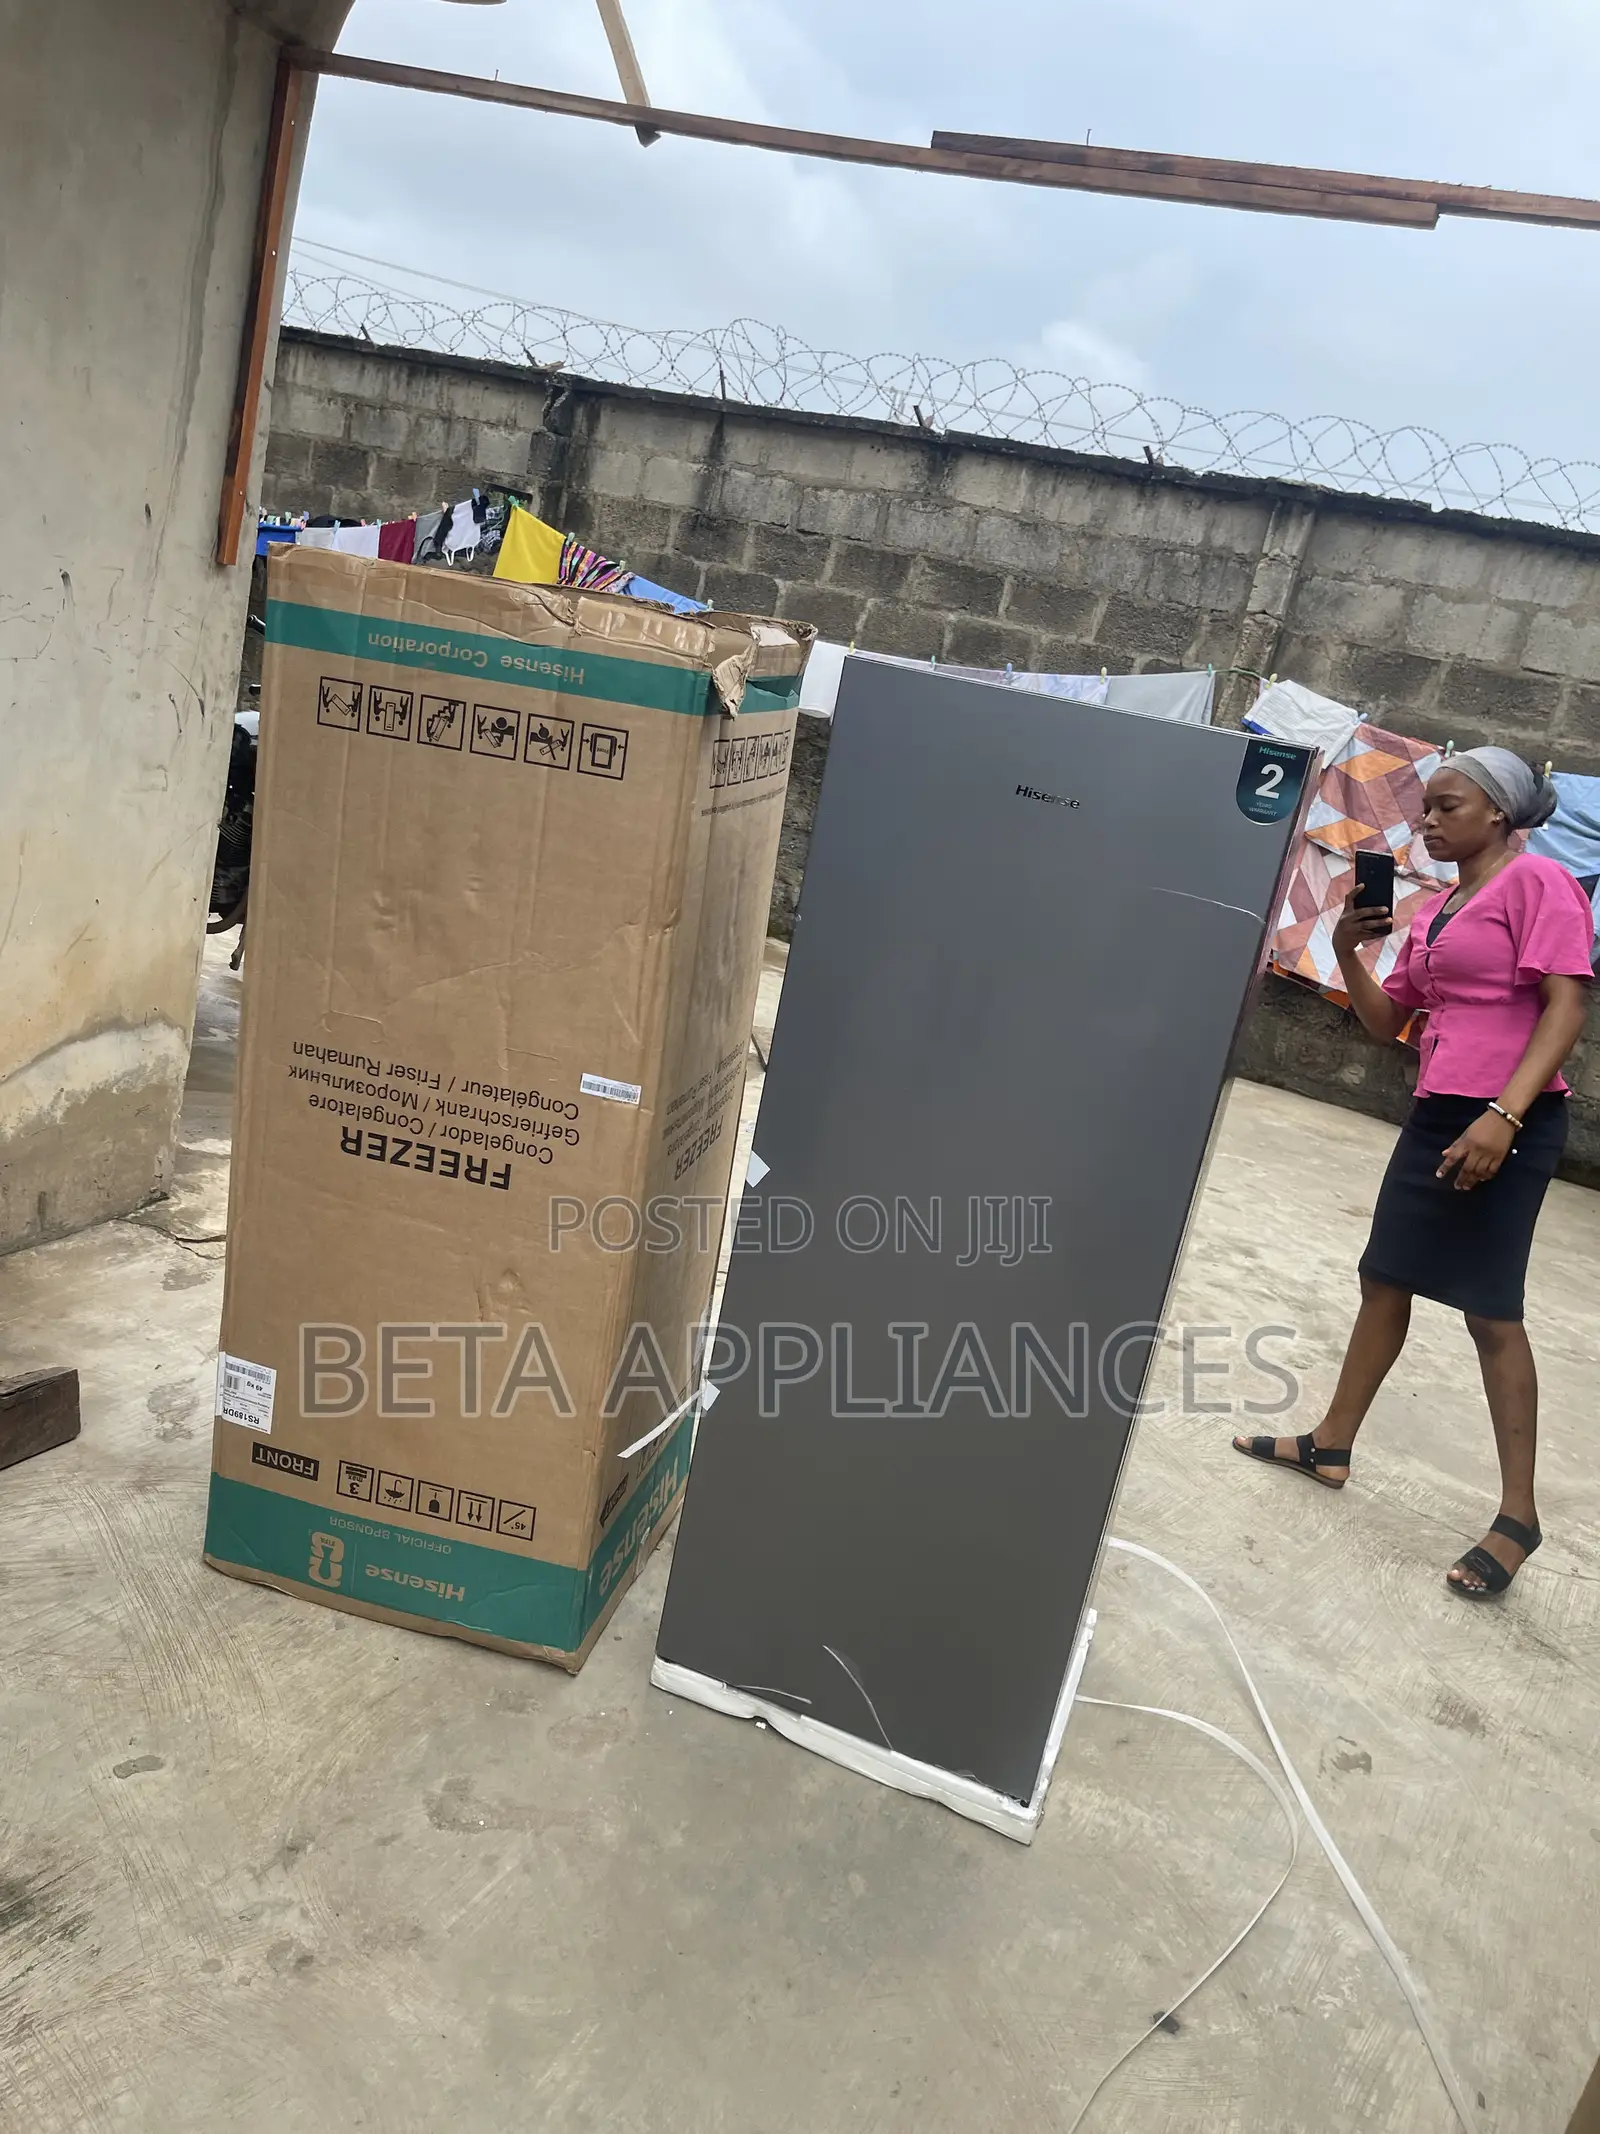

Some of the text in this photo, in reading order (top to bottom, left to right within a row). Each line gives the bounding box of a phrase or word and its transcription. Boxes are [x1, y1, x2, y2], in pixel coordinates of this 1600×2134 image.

[368, 632, 585, 685] Hisense Corporation
[1259, 746, 1297, 760] Hisense
[1255, 763, 1284, 800] 2
[292, 1041, 381, 1077] Rumahan
[387, 1062, 441, 1091] Friser
[308, 1094, 424, 1135] Congelatore
[461, 1080, 579, 1121] Congélateur
[435, 1098, 580, 1146] Gefrierschrank
[340, 1125, 512, 1190] FREEZER
[440, 1124, 554, 1165] Congelador
[674, 1115, 724, 1181] FREEZER
[255, 1447, 315, 1477] FRONT
[347, 1474, 364, 1483] max
[350, 1482, 360, 1496] 3
[329, 1515, 452, 1555] OFFICIAL SPONSOR
[600, 1455, 679, 1597] Hisense
[365, 1564, 466, 1602] Hisense
